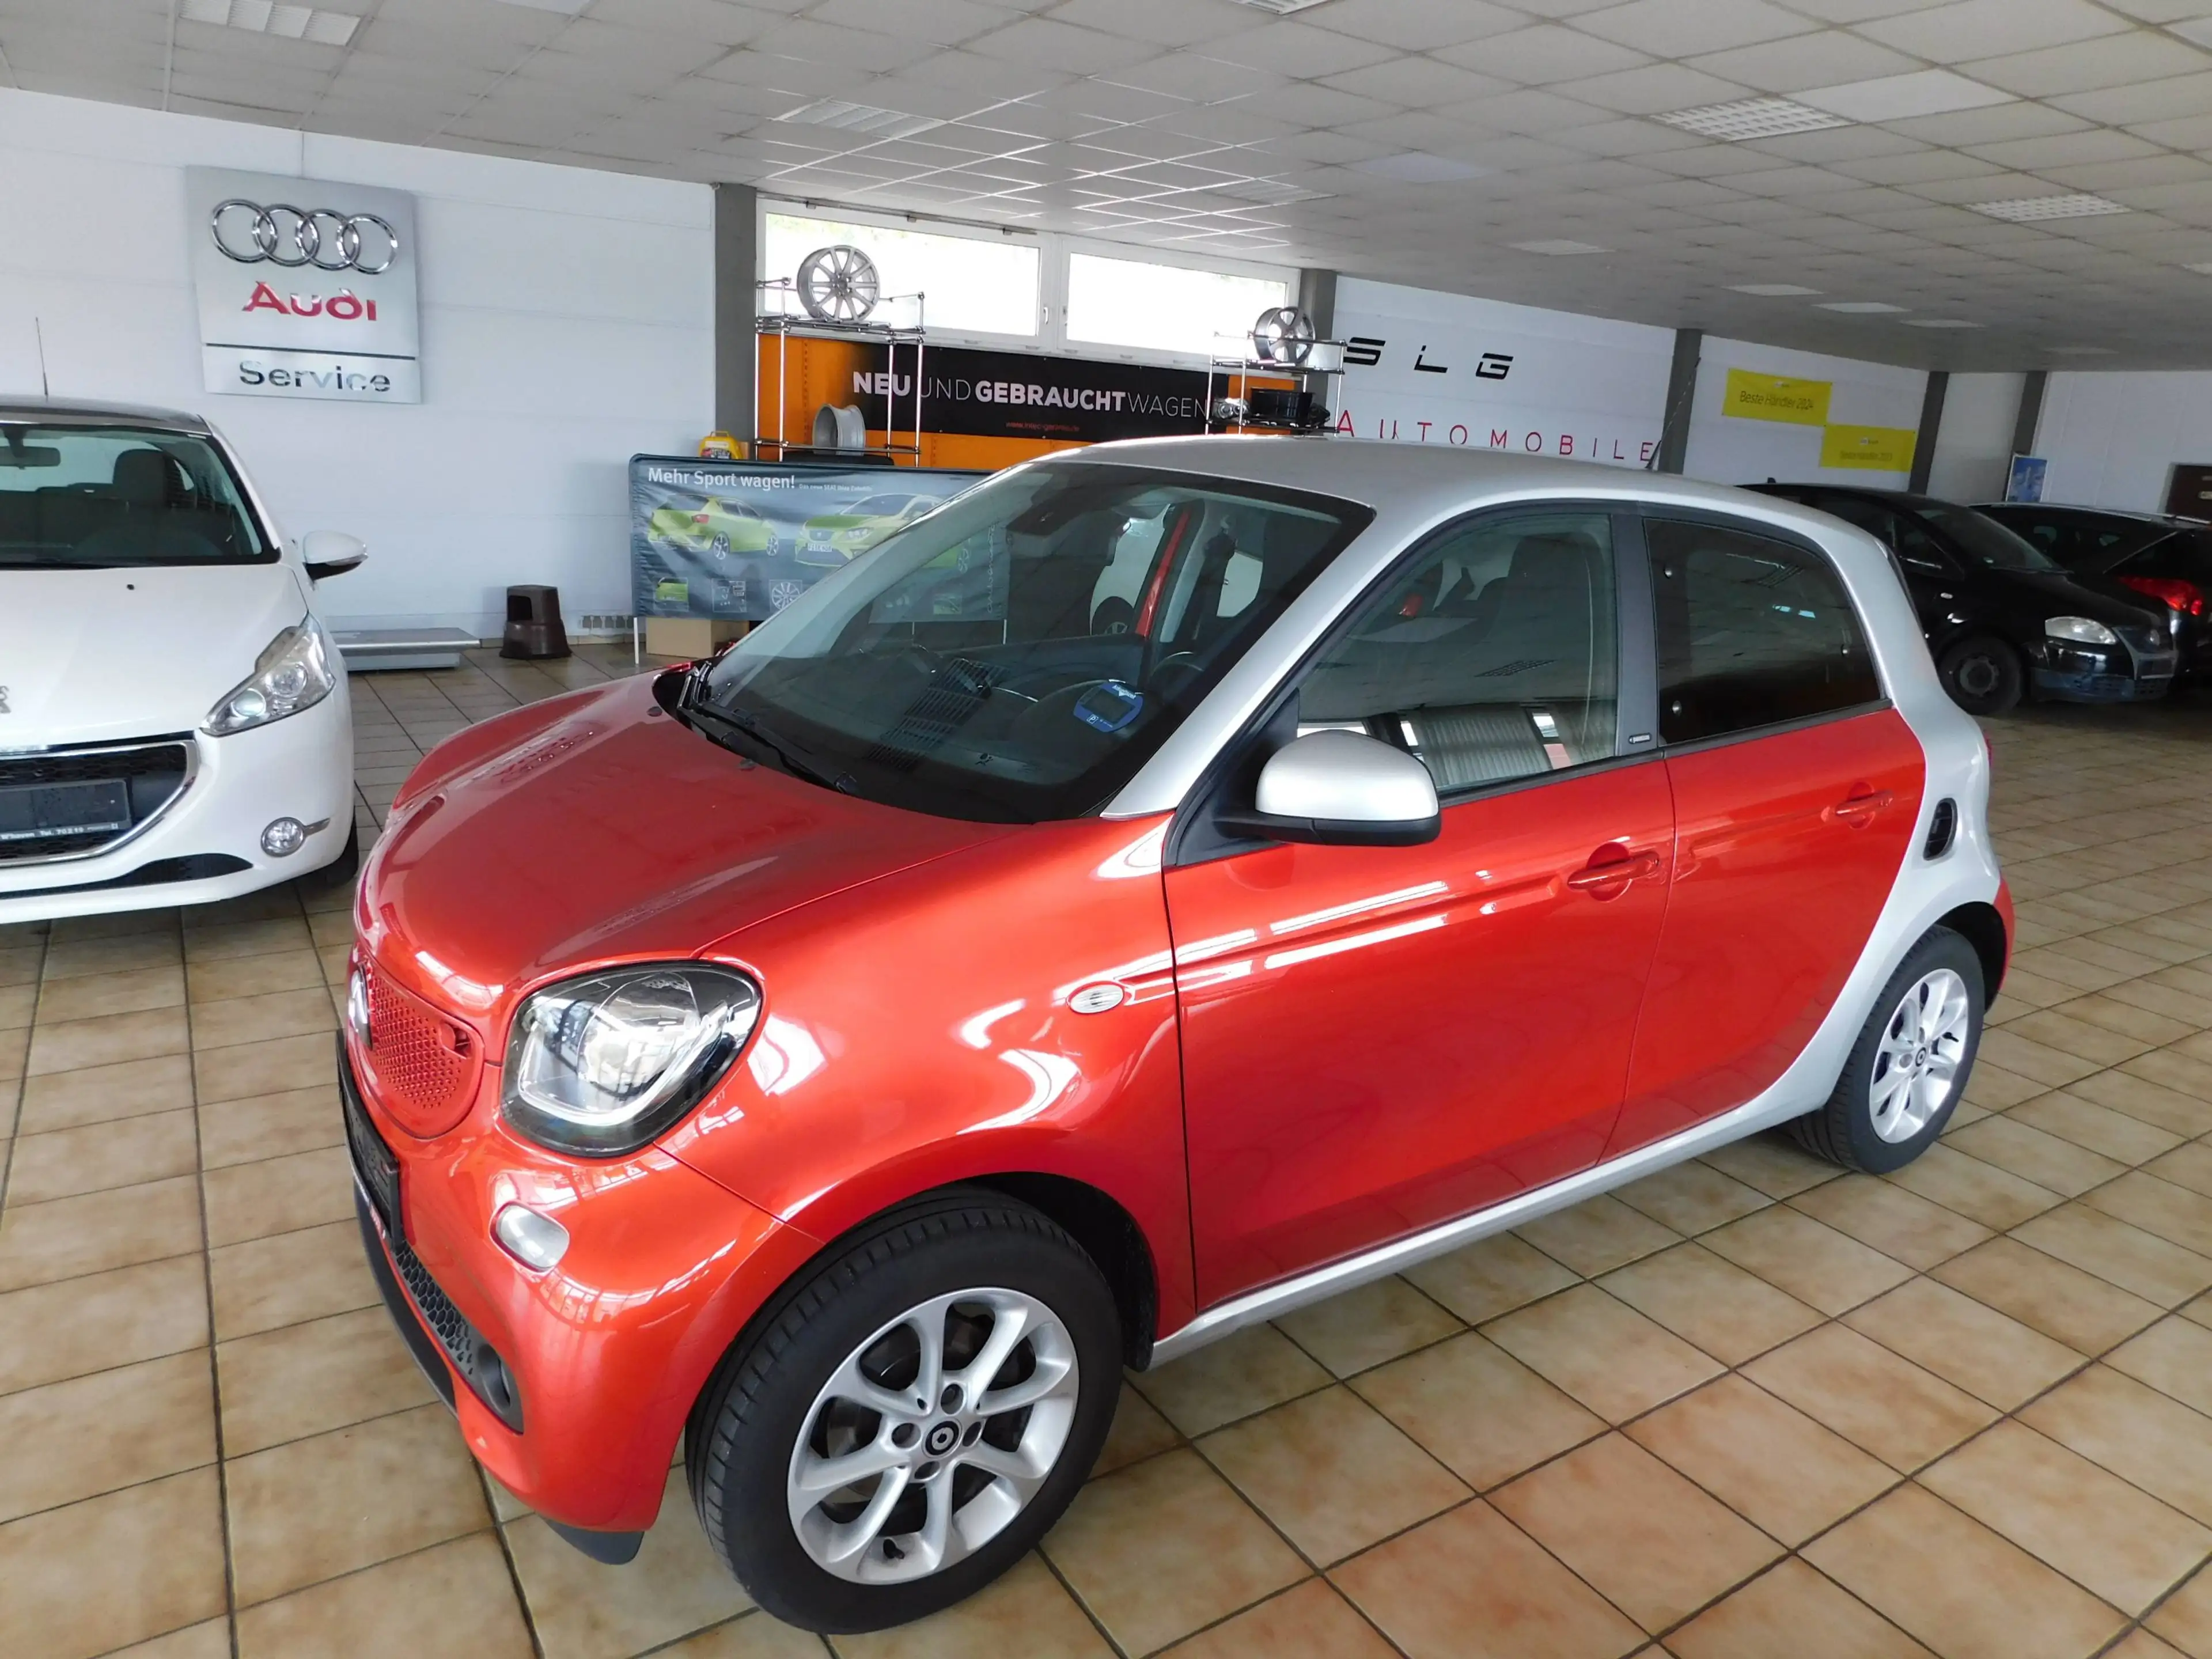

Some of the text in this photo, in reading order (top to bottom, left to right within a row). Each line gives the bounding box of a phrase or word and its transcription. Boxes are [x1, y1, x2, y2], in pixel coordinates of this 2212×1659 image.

[241, 280, 377, 321] Audi
[1343, 337, 1514, 380] SLG
[240, 360, 391, 392] Service
[853, 371, 910, 396] NEU
[919, 377, 971, 400] UND
[648, 467, 795, 491] Mehr Sport wagen!
